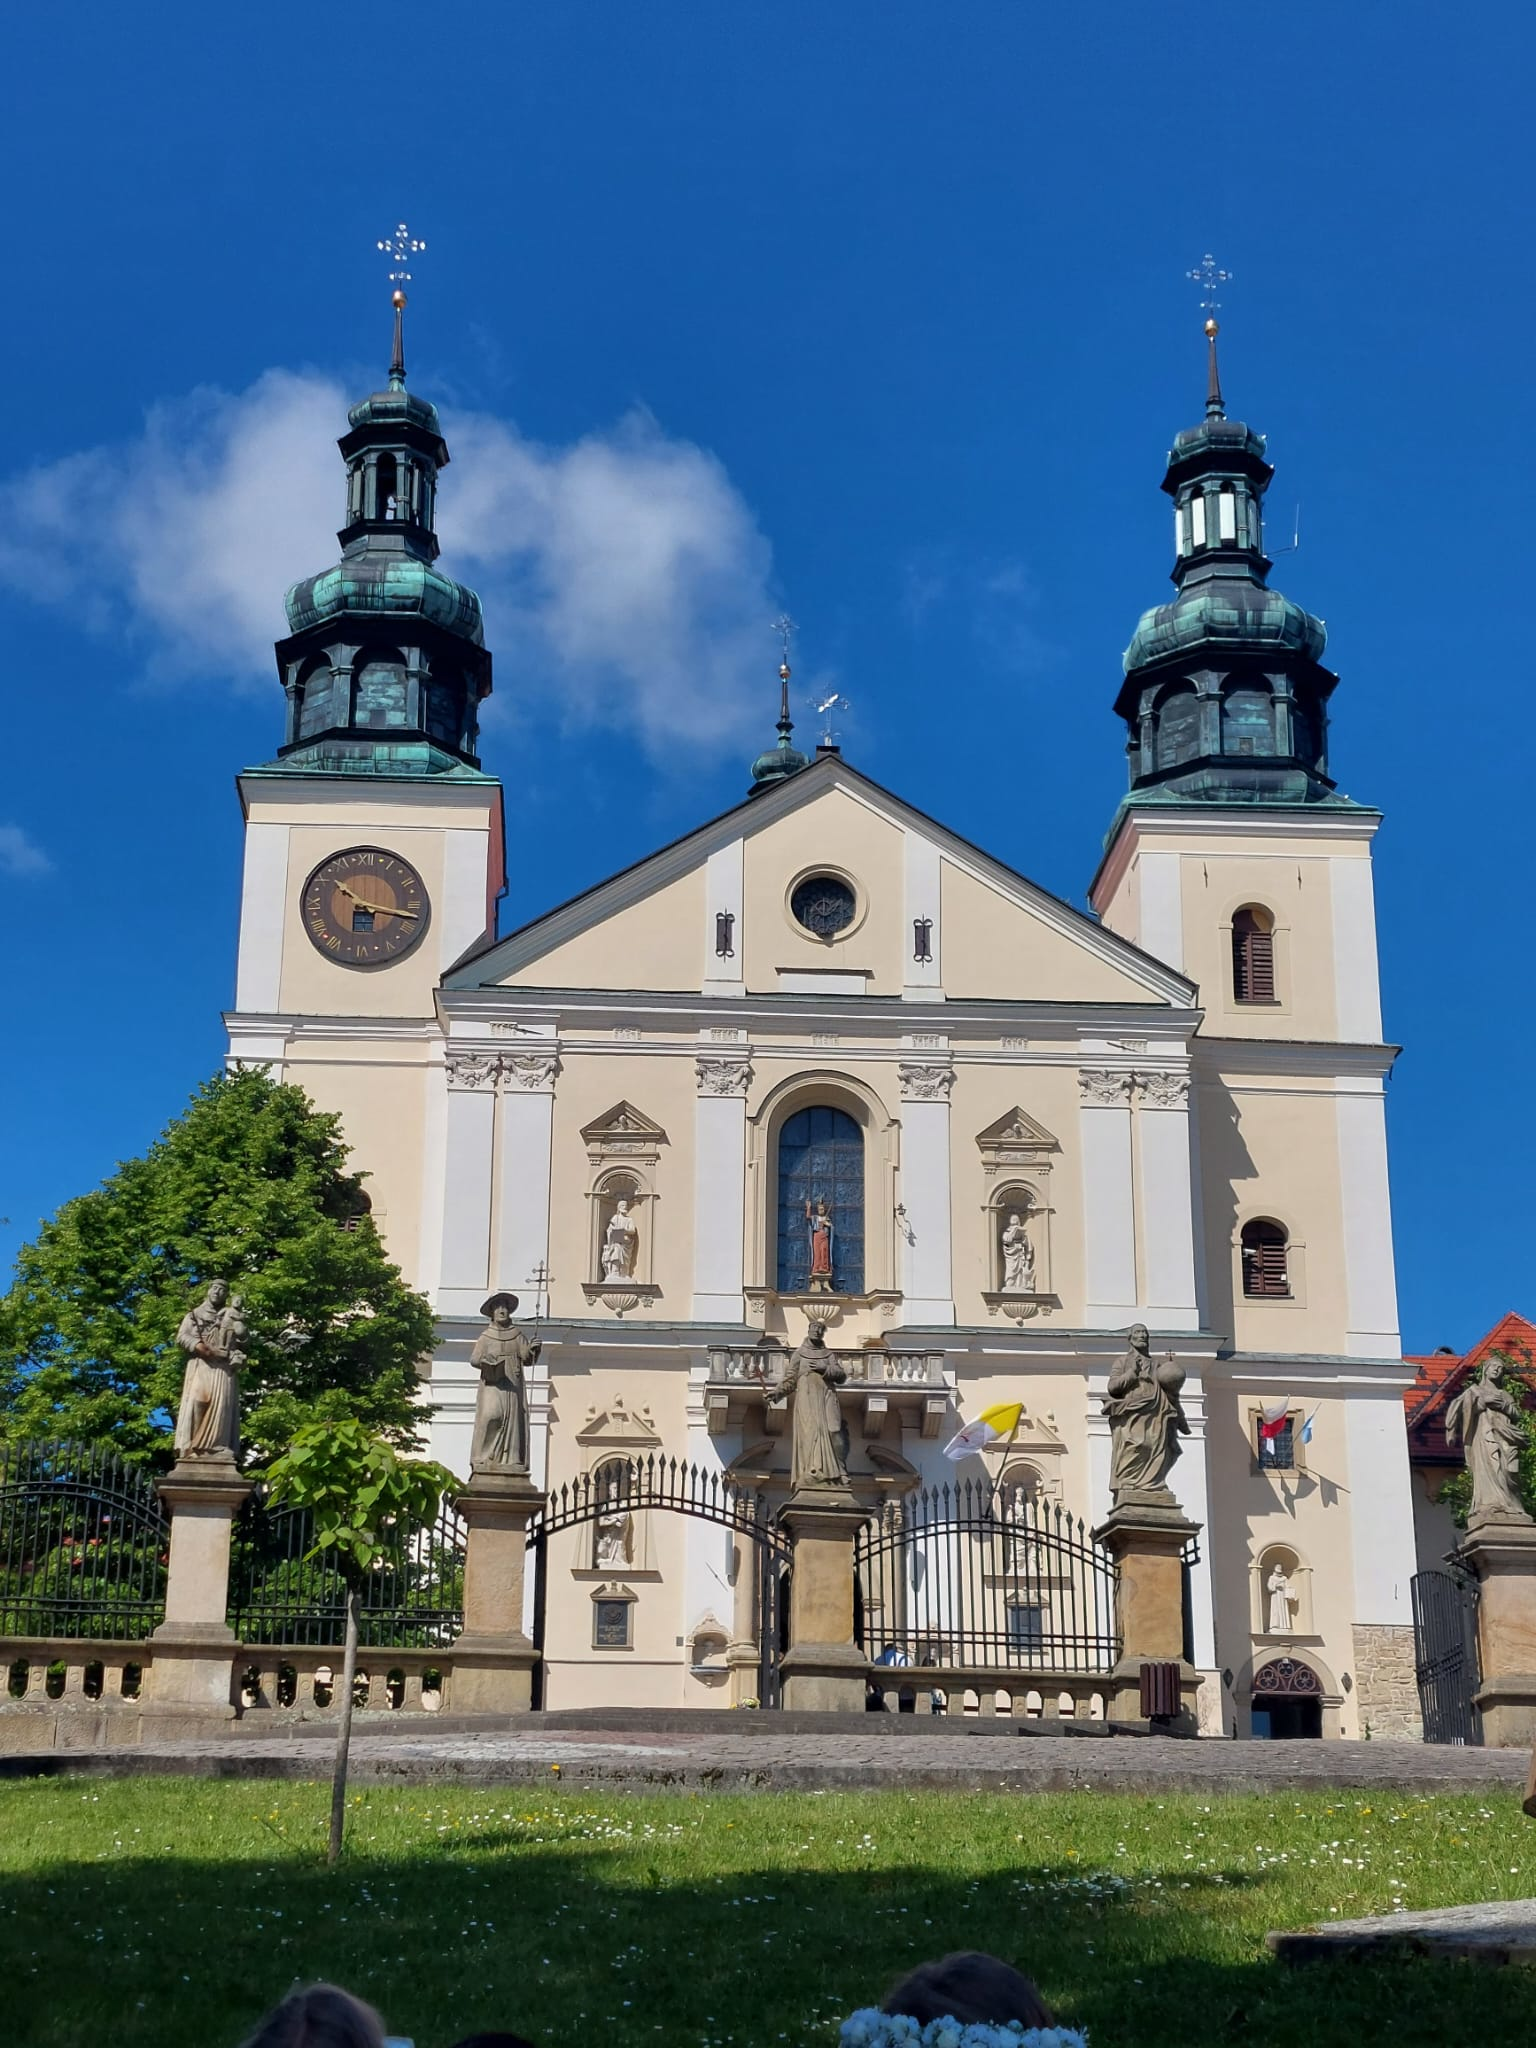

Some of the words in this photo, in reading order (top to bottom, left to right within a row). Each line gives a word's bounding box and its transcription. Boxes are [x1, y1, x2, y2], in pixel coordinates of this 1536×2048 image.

[332, 857, 350, 872] XI
[358, 853, 374, 866] XII
[385, 860, 394, 870] I
[314, 873, 330, 887] X
[401, 877, 415, 887] II
[307, 897, 321, 910] IX
[407, 901, 421, 909] III
[326, 935, 342, 952] VII
[385, 940, 396, 952] V
[356, 945, 369, 957] VI
